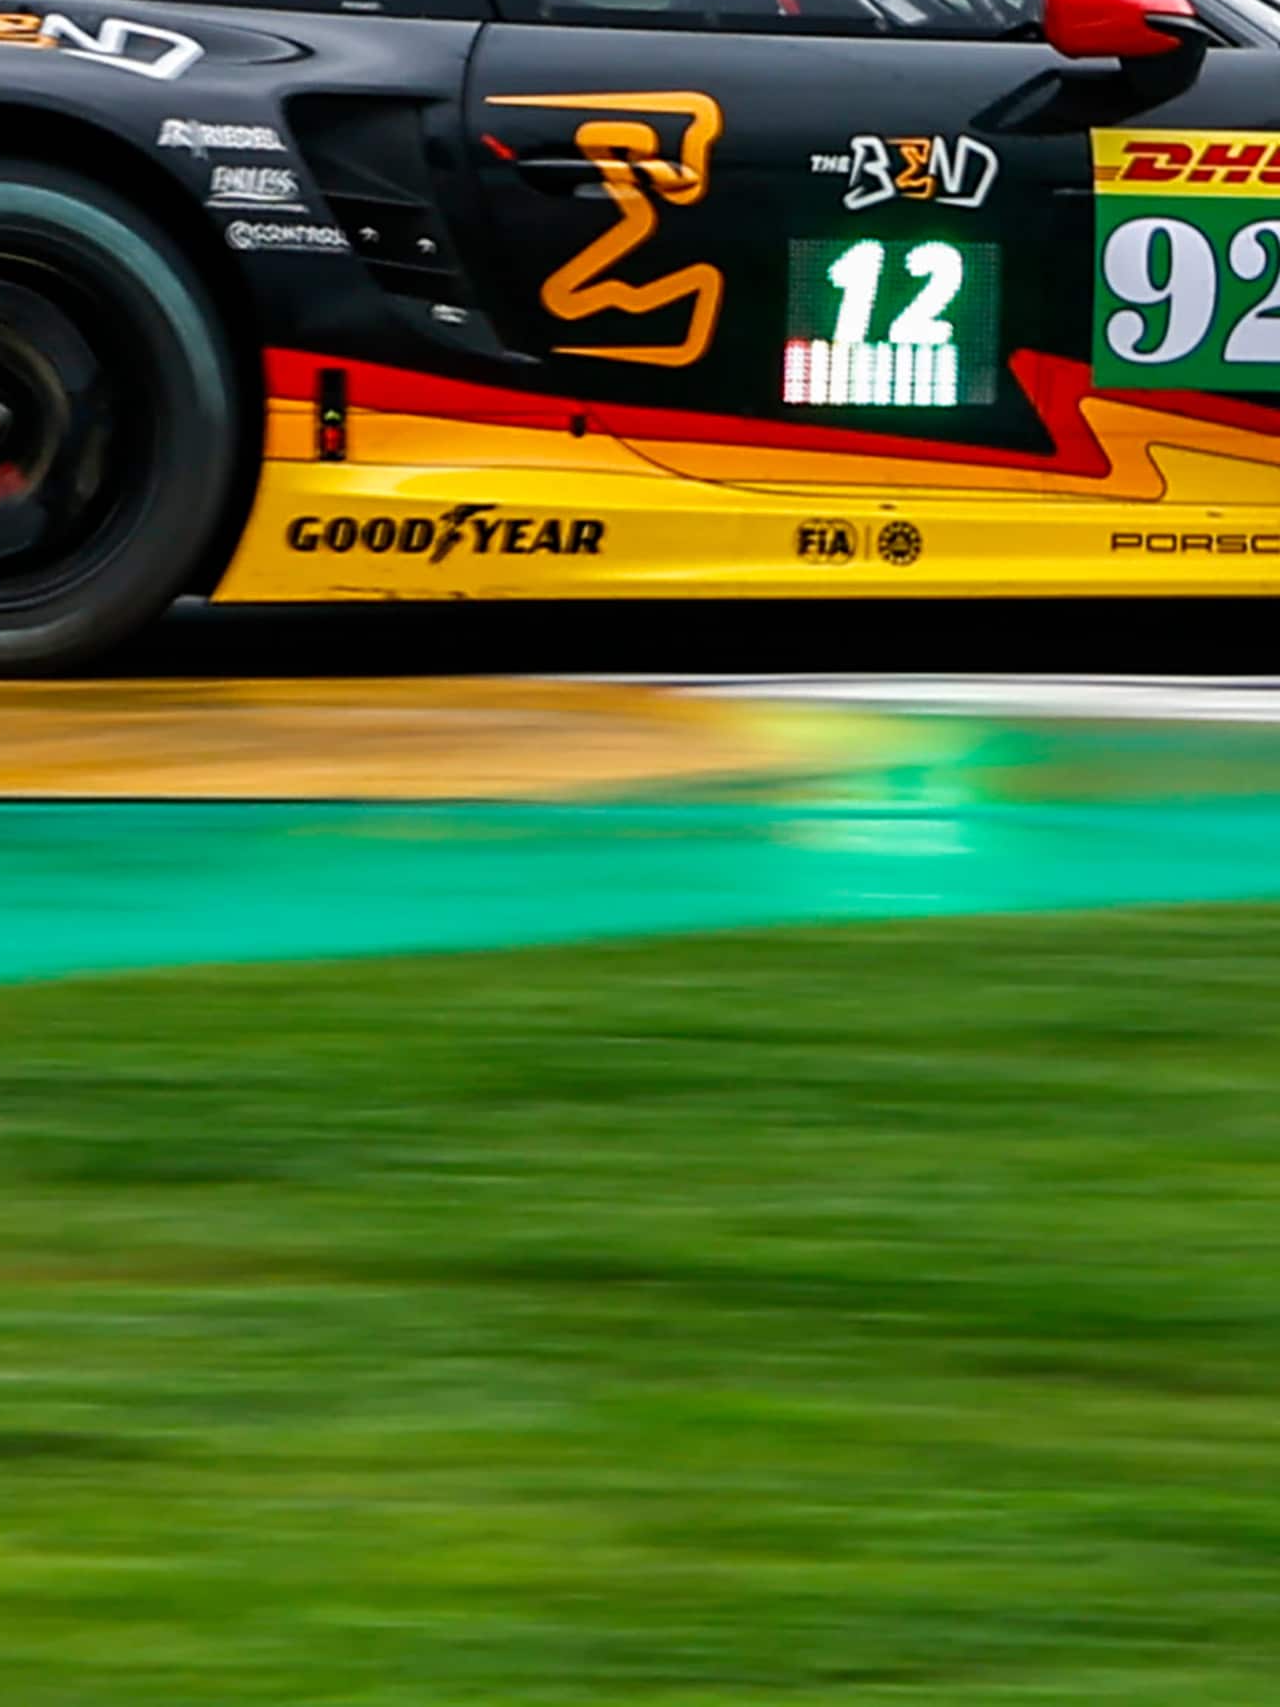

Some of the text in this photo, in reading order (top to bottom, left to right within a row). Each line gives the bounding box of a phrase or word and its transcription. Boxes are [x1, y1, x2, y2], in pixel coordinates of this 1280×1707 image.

[210, 165, 300, 194] ENDLESS
[809, 154, 851, 174] THE
[1120, 140, 1280, 184] DH
[827, 239, 964, 344] 12
[286, 503, 606, 565] GOODYEAR
